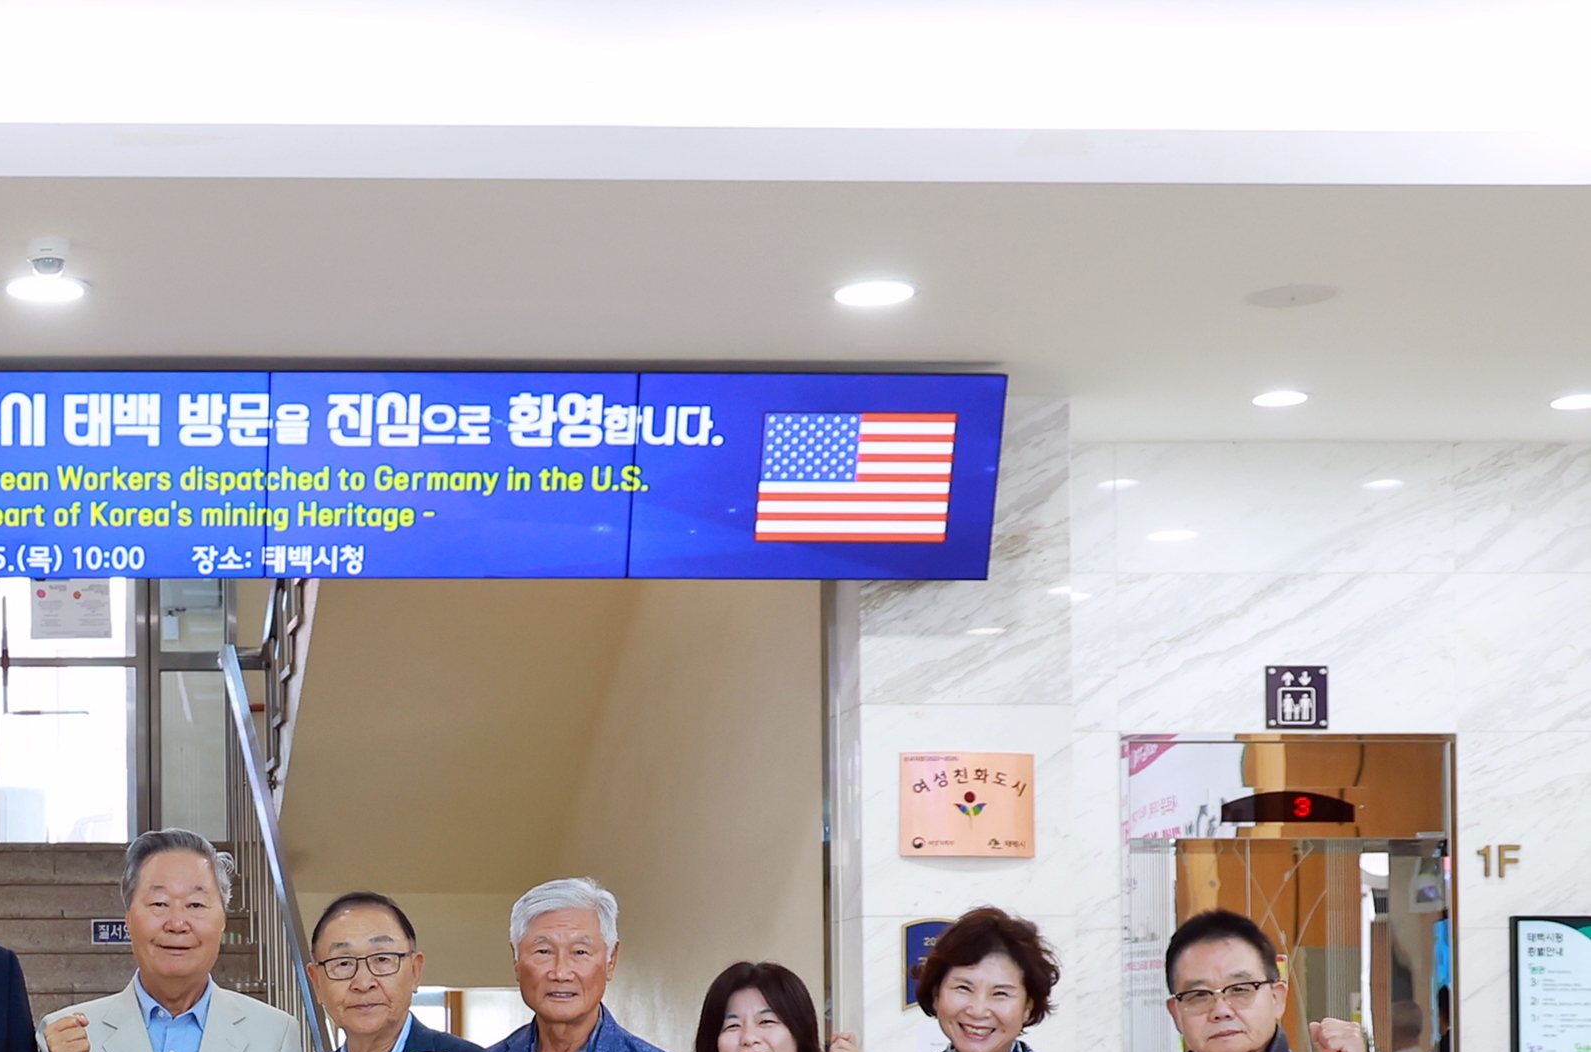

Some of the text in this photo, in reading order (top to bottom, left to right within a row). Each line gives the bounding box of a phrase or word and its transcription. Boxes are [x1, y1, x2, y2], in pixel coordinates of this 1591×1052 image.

[63, 393, 161, 447] 태백
[178, 393, 310, 447] 방문을
[327, 392, 491, 447] 진심으로
[507, 393, 724, 447] 환영합니다.
[58, 466, 172, 491] Workers
[181, 466, 330, 496] dispatched
[339, 470, 365, 491] to
[375, 465, 499, 496] Germany
[508, 467, 531, 491] in
[539, 467, 583, 492] the
[591, 465, 649, 492] U.S.
[55, 501, 81, 527] of
[91, 501, 193, 527] Korea's
[202, 503, 289, 532] mining
[299, 503, 415, 532] Heritage
[72, 546, 145, 570] 10:00
[191, 544, 364, 575] 장소: 태백시청
[912, 767, 1027, 797] 여성친화도시
[1293, 796, 1312, 817] 3
[1476, 844, 1521, 878] 1F
